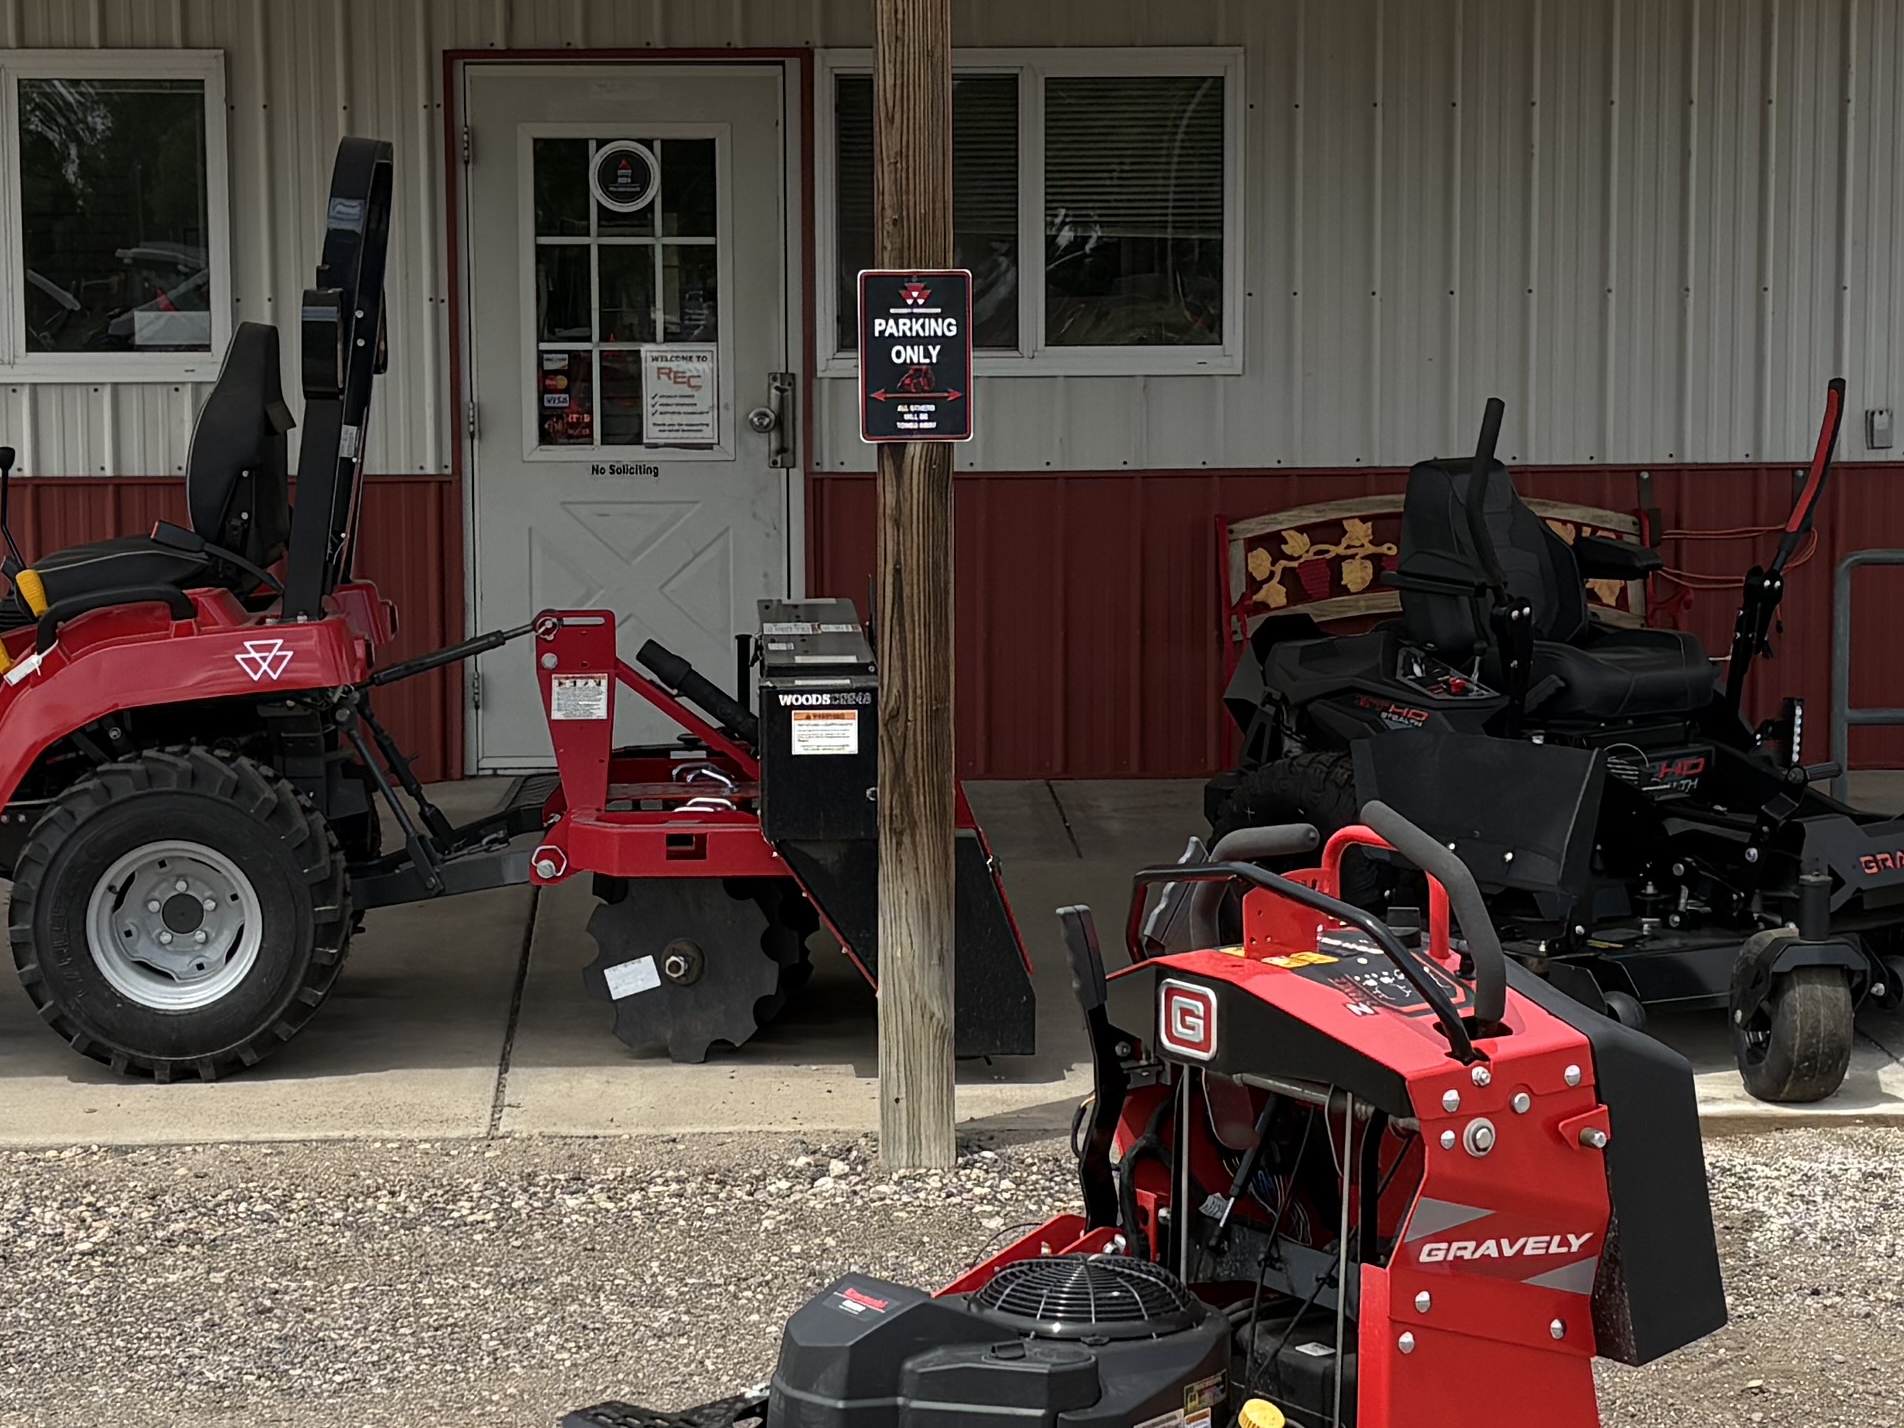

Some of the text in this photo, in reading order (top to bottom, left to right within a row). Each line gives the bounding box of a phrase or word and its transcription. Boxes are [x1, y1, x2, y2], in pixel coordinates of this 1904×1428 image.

[874, 317, 957, 337] PARKING
[891, 345, 941, 364] ONLY
[656, 366, 703, 391] REC
[591, 464, 659, 477] No Soliciting
[778, 694, 831, 706] WOODS
[1419, 1231, 1594, 1262] GRAVELY
